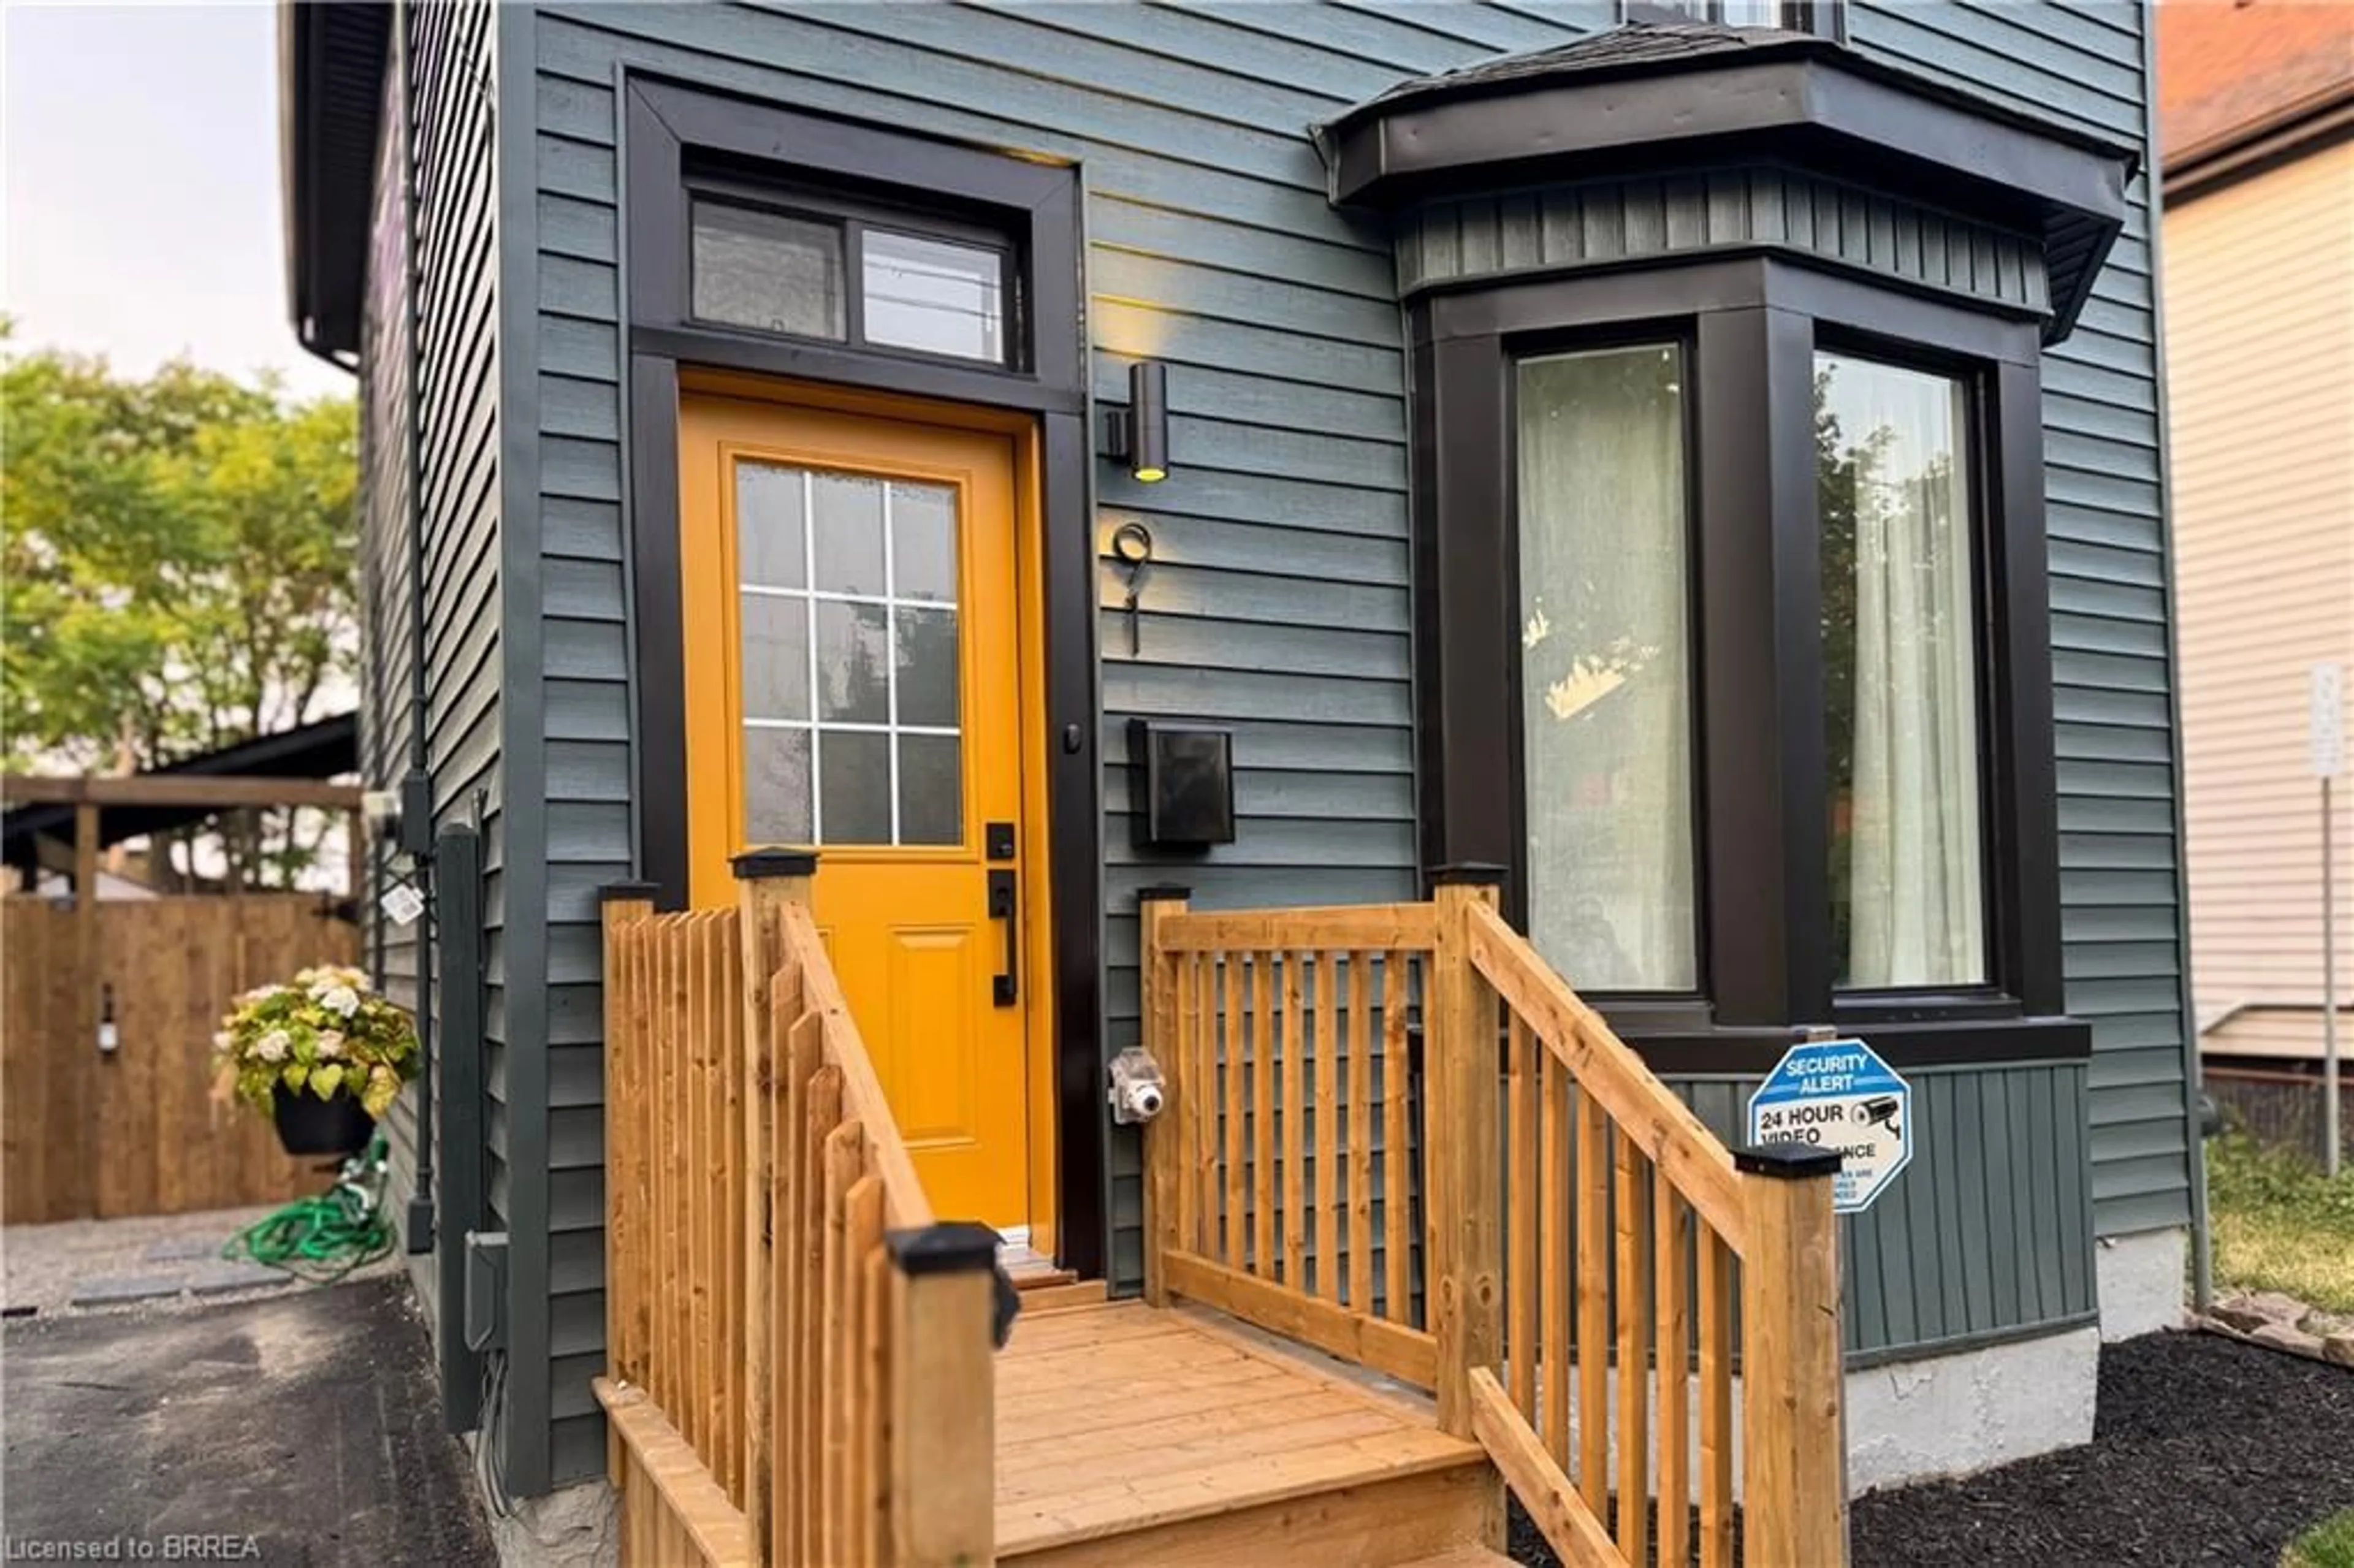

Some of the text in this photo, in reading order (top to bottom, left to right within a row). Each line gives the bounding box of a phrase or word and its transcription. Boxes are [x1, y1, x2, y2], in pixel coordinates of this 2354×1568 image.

[1786, 1054, 1867, 1076] SECURITY
[1799, 1073, 1853, 1095] ALERT
[1761, 1104, 1843, 1129] 24 HOUR
